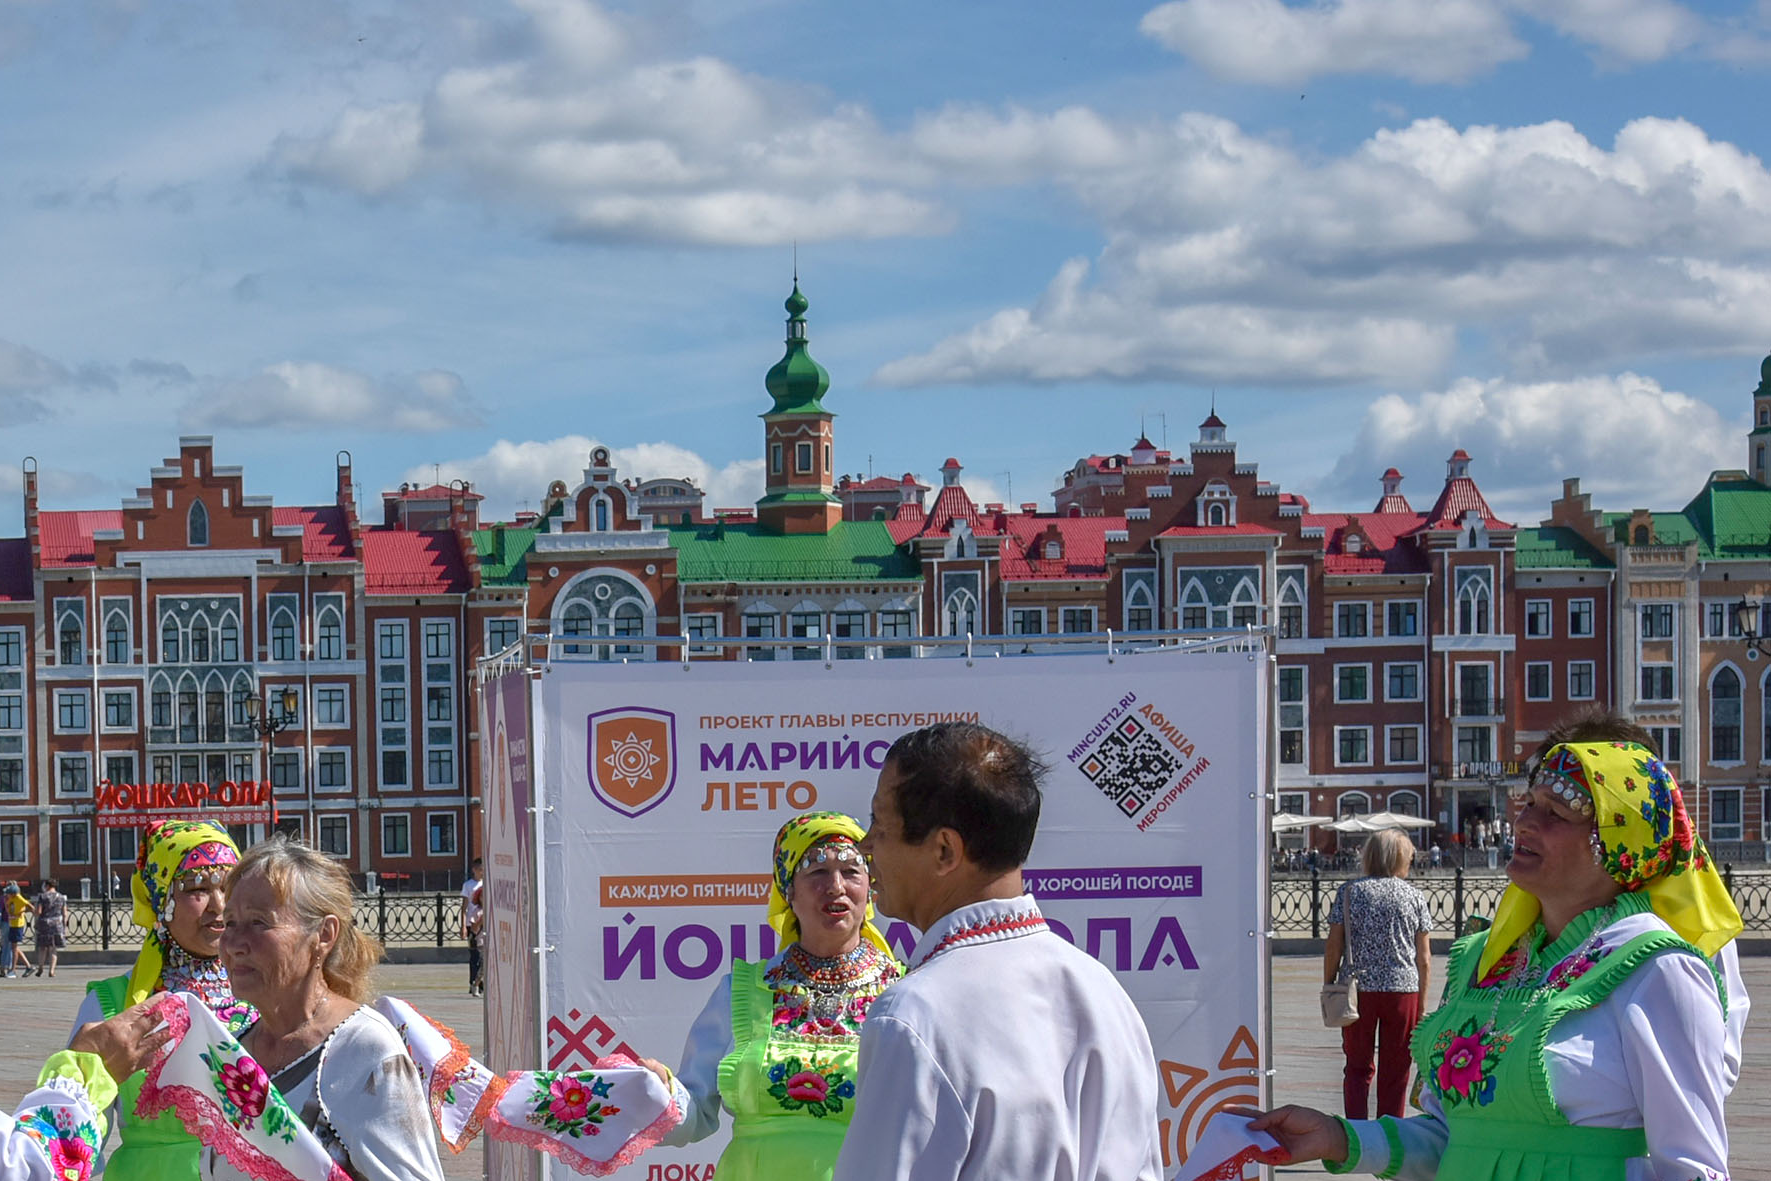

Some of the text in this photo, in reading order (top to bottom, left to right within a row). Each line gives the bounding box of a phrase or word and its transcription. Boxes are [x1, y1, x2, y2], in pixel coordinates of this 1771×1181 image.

[699, 711, 979, 729] ПРОЕКТ ГЛАВЫ РЕСПУБЛИКИ
[1067, 691, 1137, 763] MINCULT12.RU
[1138, 703, 1195, 759] АФИША
[700, 734, 891, 771] МАРИЙС
[96, 778, 270, 810] ЙОШКАР-ОЛА
[701, 781, 818, 811] ЛЕТО
[1137, 756, 1210, 832] МЕРОПРИЯТИЙ
[608, 884, 688, 900] КАЖДУЮ
[1038, 874, 1122, 892] ХОРОШЕЙ
[1127, 875, 1194, 890] ПОГОДЕ
